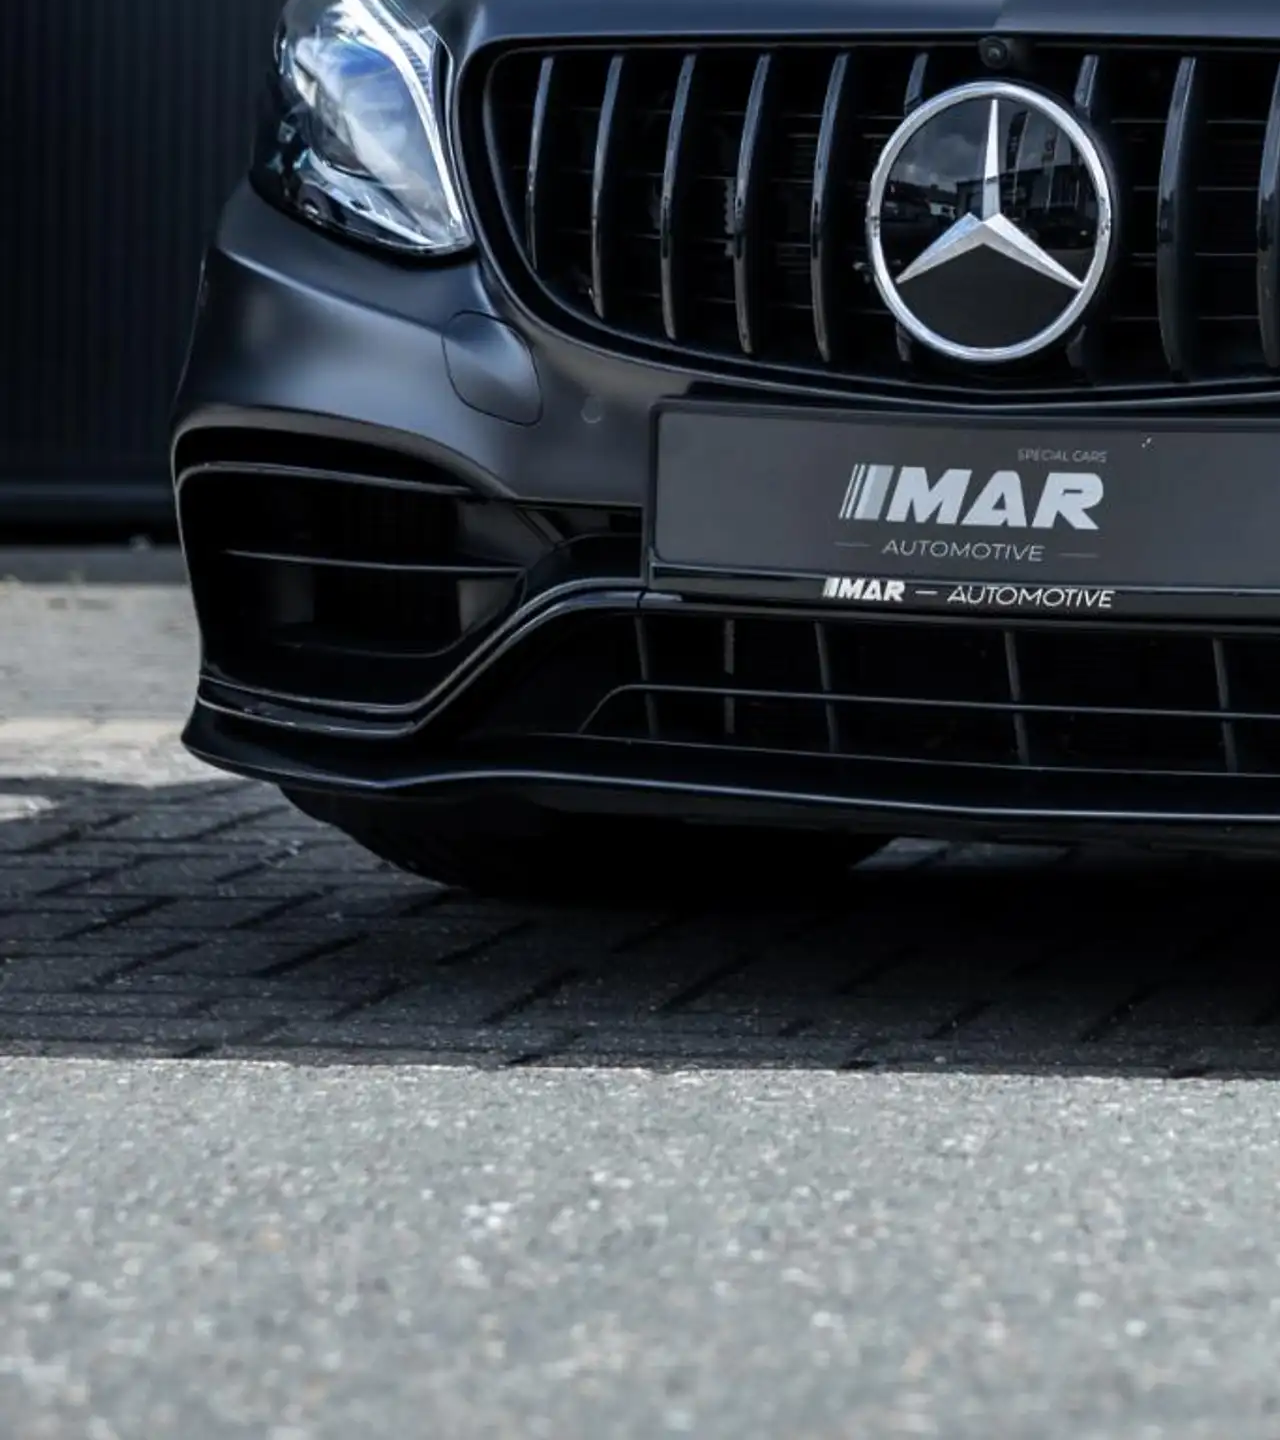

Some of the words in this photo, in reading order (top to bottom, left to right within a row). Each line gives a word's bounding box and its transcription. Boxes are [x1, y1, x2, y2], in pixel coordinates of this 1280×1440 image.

[1017, 448, 1069, 463] SPECIAL
[1071, 449, 1109, 464] CARS
[881, 539, 1046, 563] AUTOMOTIVE
[946, 584, 1116, 609] AUTOMOTIVE
